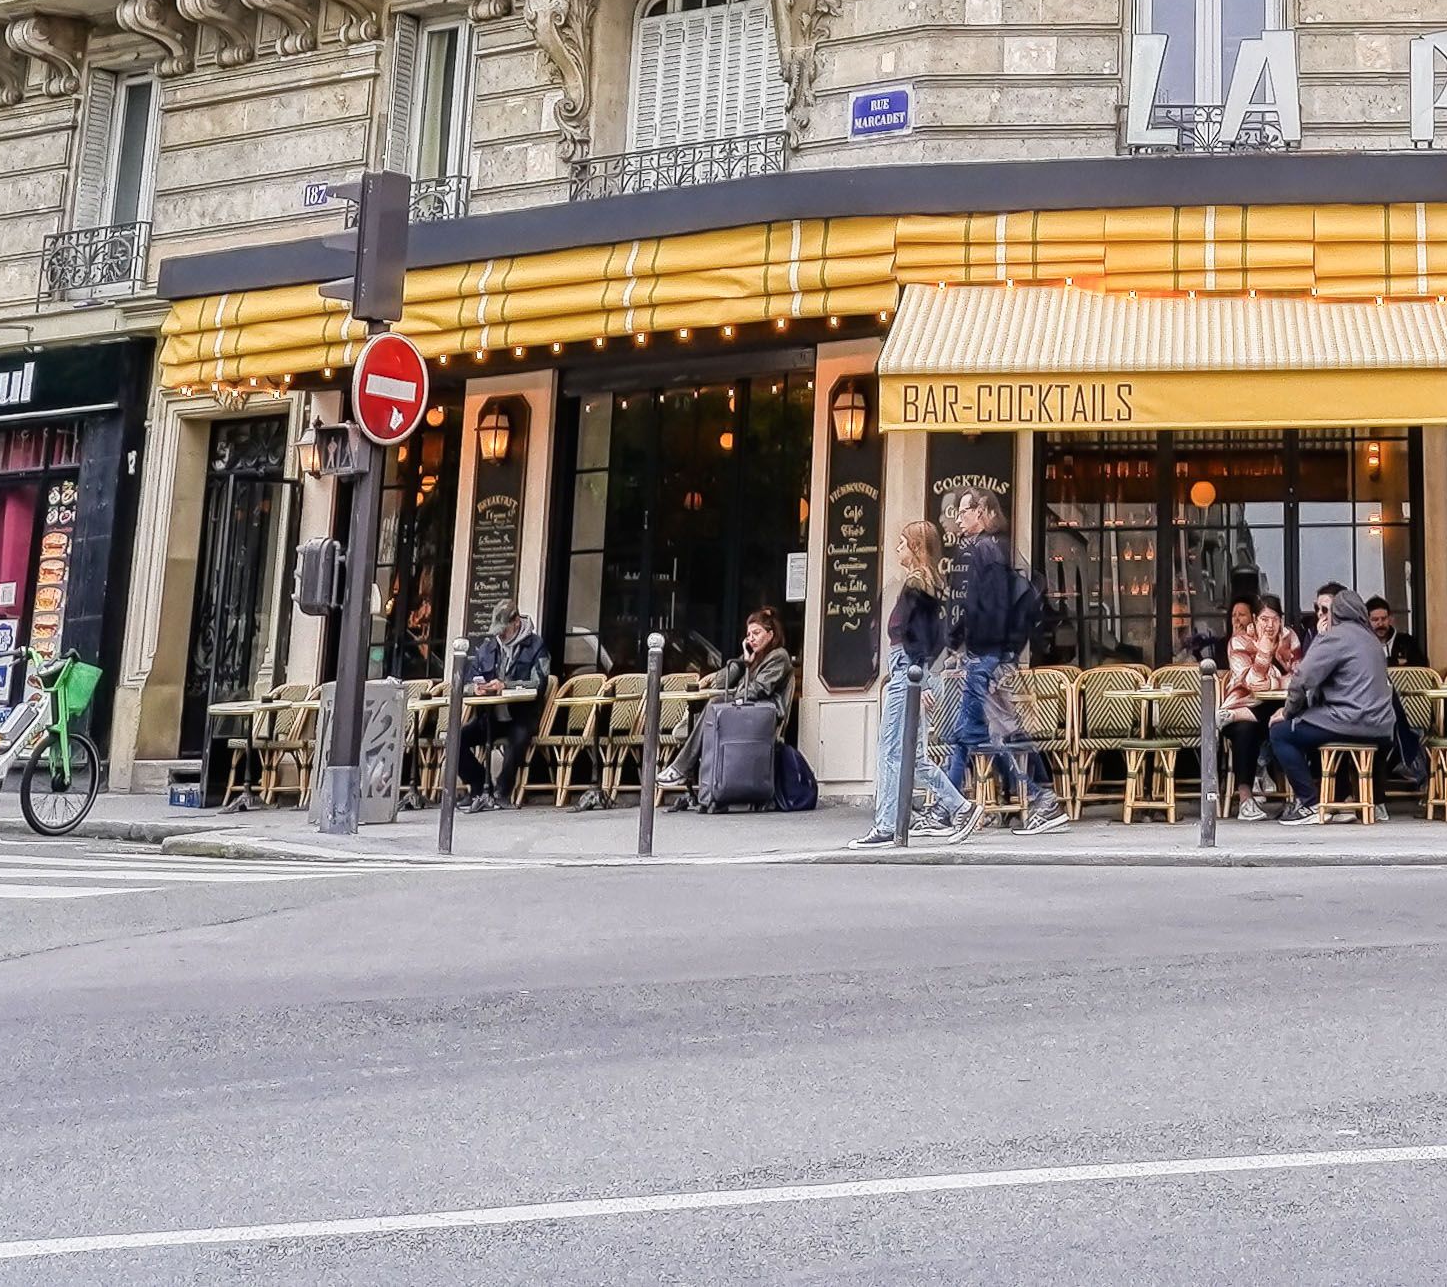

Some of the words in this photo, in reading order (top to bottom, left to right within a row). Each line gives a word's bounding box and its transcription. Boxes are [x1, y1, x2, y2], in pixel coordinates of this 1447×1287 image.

[1126, 29, 1301, 146] LA
[870, 98, 890, 111] RUE
[854, 112, 906, 129] MARCADET
[305, 185, 327, 205] 187
[903, 384, 1133, 423] BAR-COCKTAILS
[932, 473, 1010, 496] COCKTAILS
